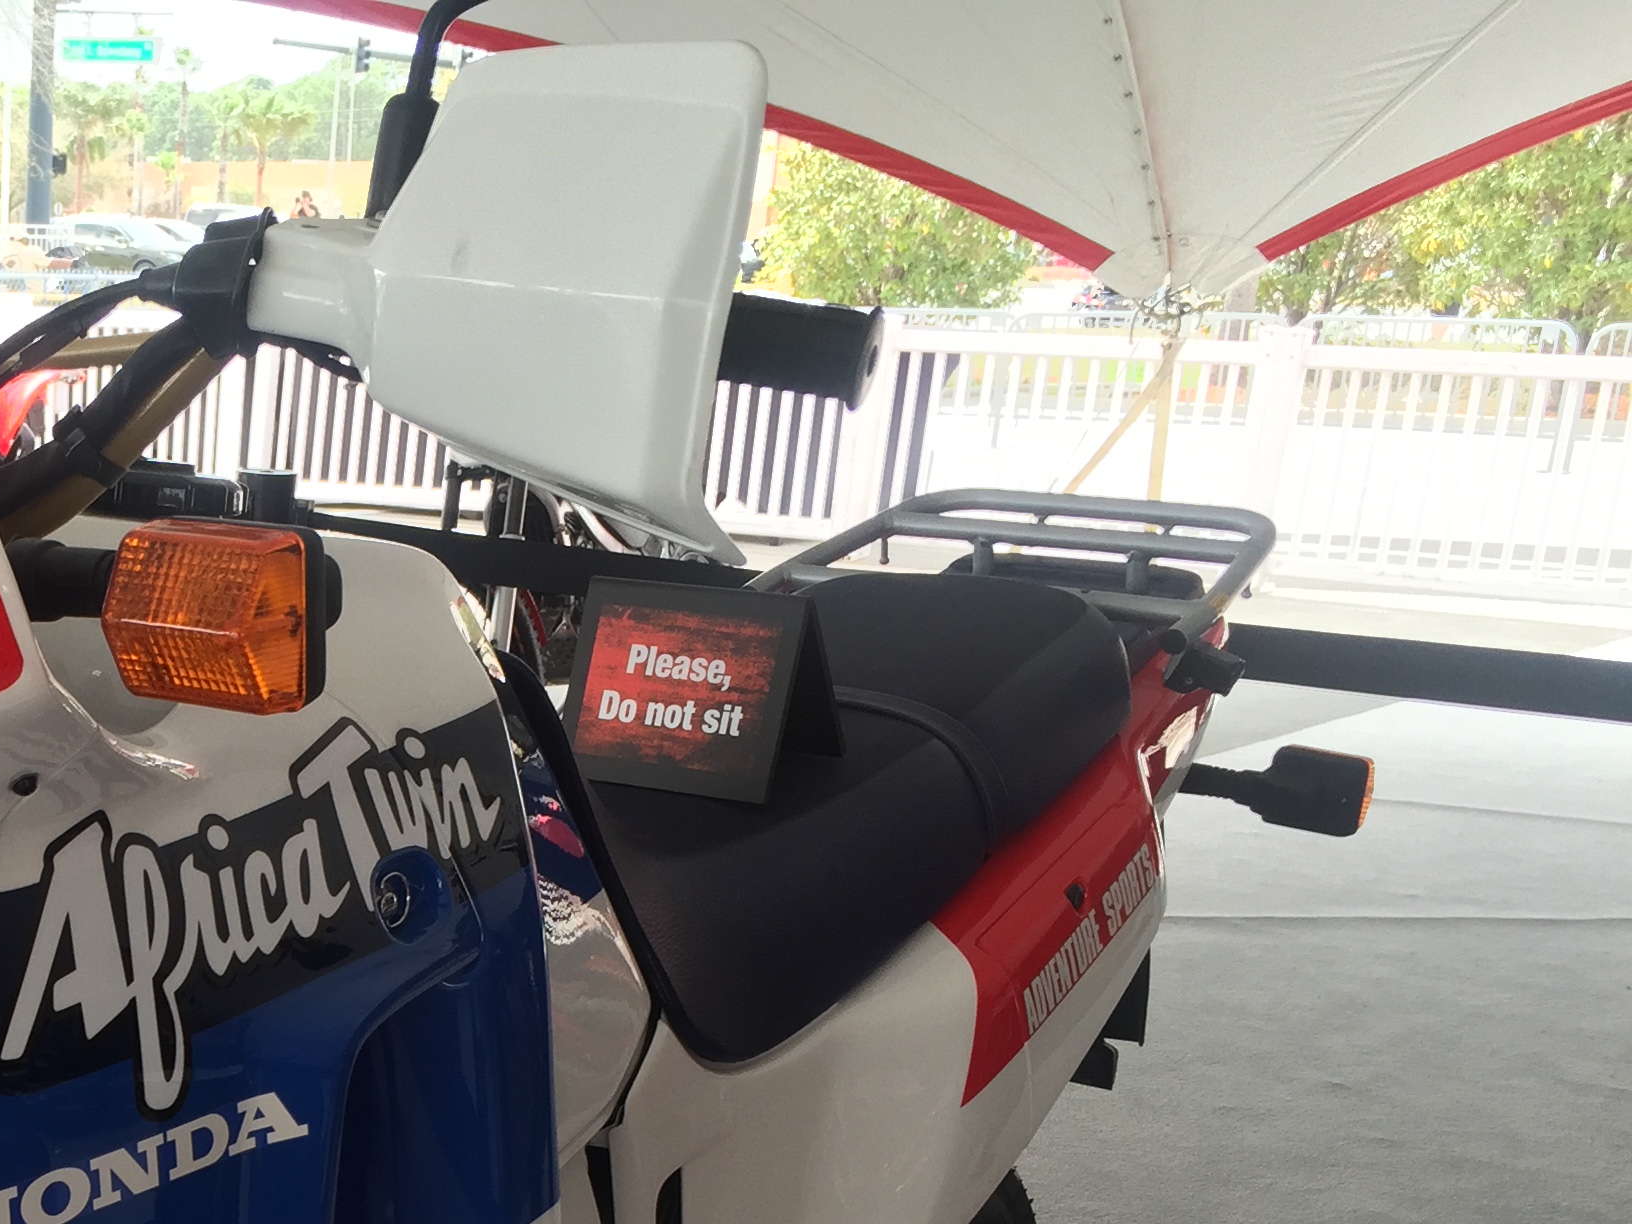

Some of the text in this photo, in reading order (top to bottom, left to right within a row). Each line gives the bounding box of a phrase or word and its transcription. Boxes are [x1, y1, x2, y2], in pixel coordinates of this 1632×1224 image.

[598, 689, 744, 737] Do not sit
[626, 643, 732, 692] Please,
[0, 723, 500, 1111] Africa Twin
[1022, 843, 1157, 1037] ADVENTURE SPORTS
